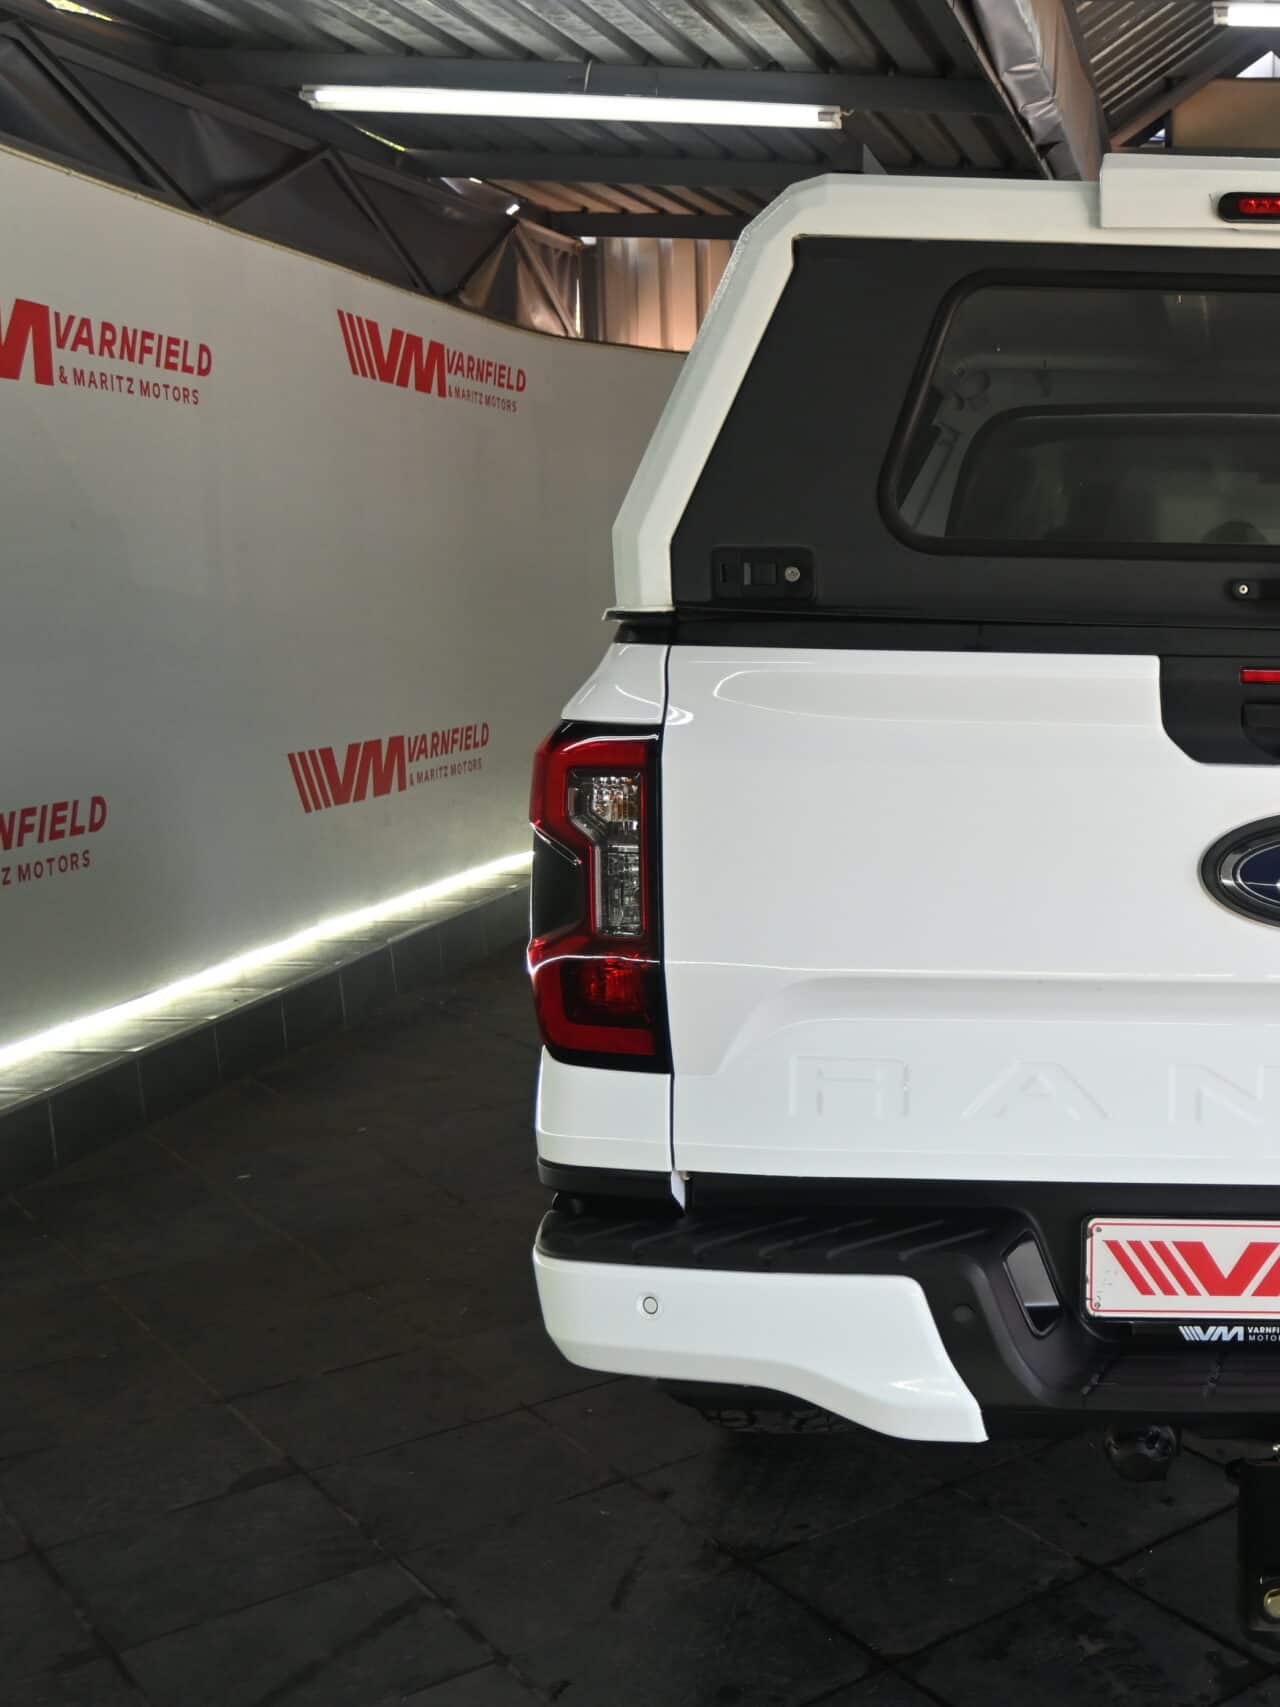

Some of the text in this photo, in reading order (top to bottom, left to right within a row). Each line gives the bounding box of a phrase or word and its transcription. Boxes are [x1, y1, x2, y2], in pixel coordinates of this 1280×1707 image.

[54, 311, 212, 377] VARNFIELD
[59, 365, 200, 405] & MARITZ MOTORS
[446, 348, 527, 393] VARNFIELD
[454, 387, 483, 405] MARITZ
[485, 395, 517, 413] MOTORS
[407, 722, 489, 764] VARNFIELD
[416, 766, 448, 784] MARITZ
[450, 758, 482, 778] MOTORS
[0, 795, 107, 850] NFIELD
[17, 849, 90, 882] MOTORS
